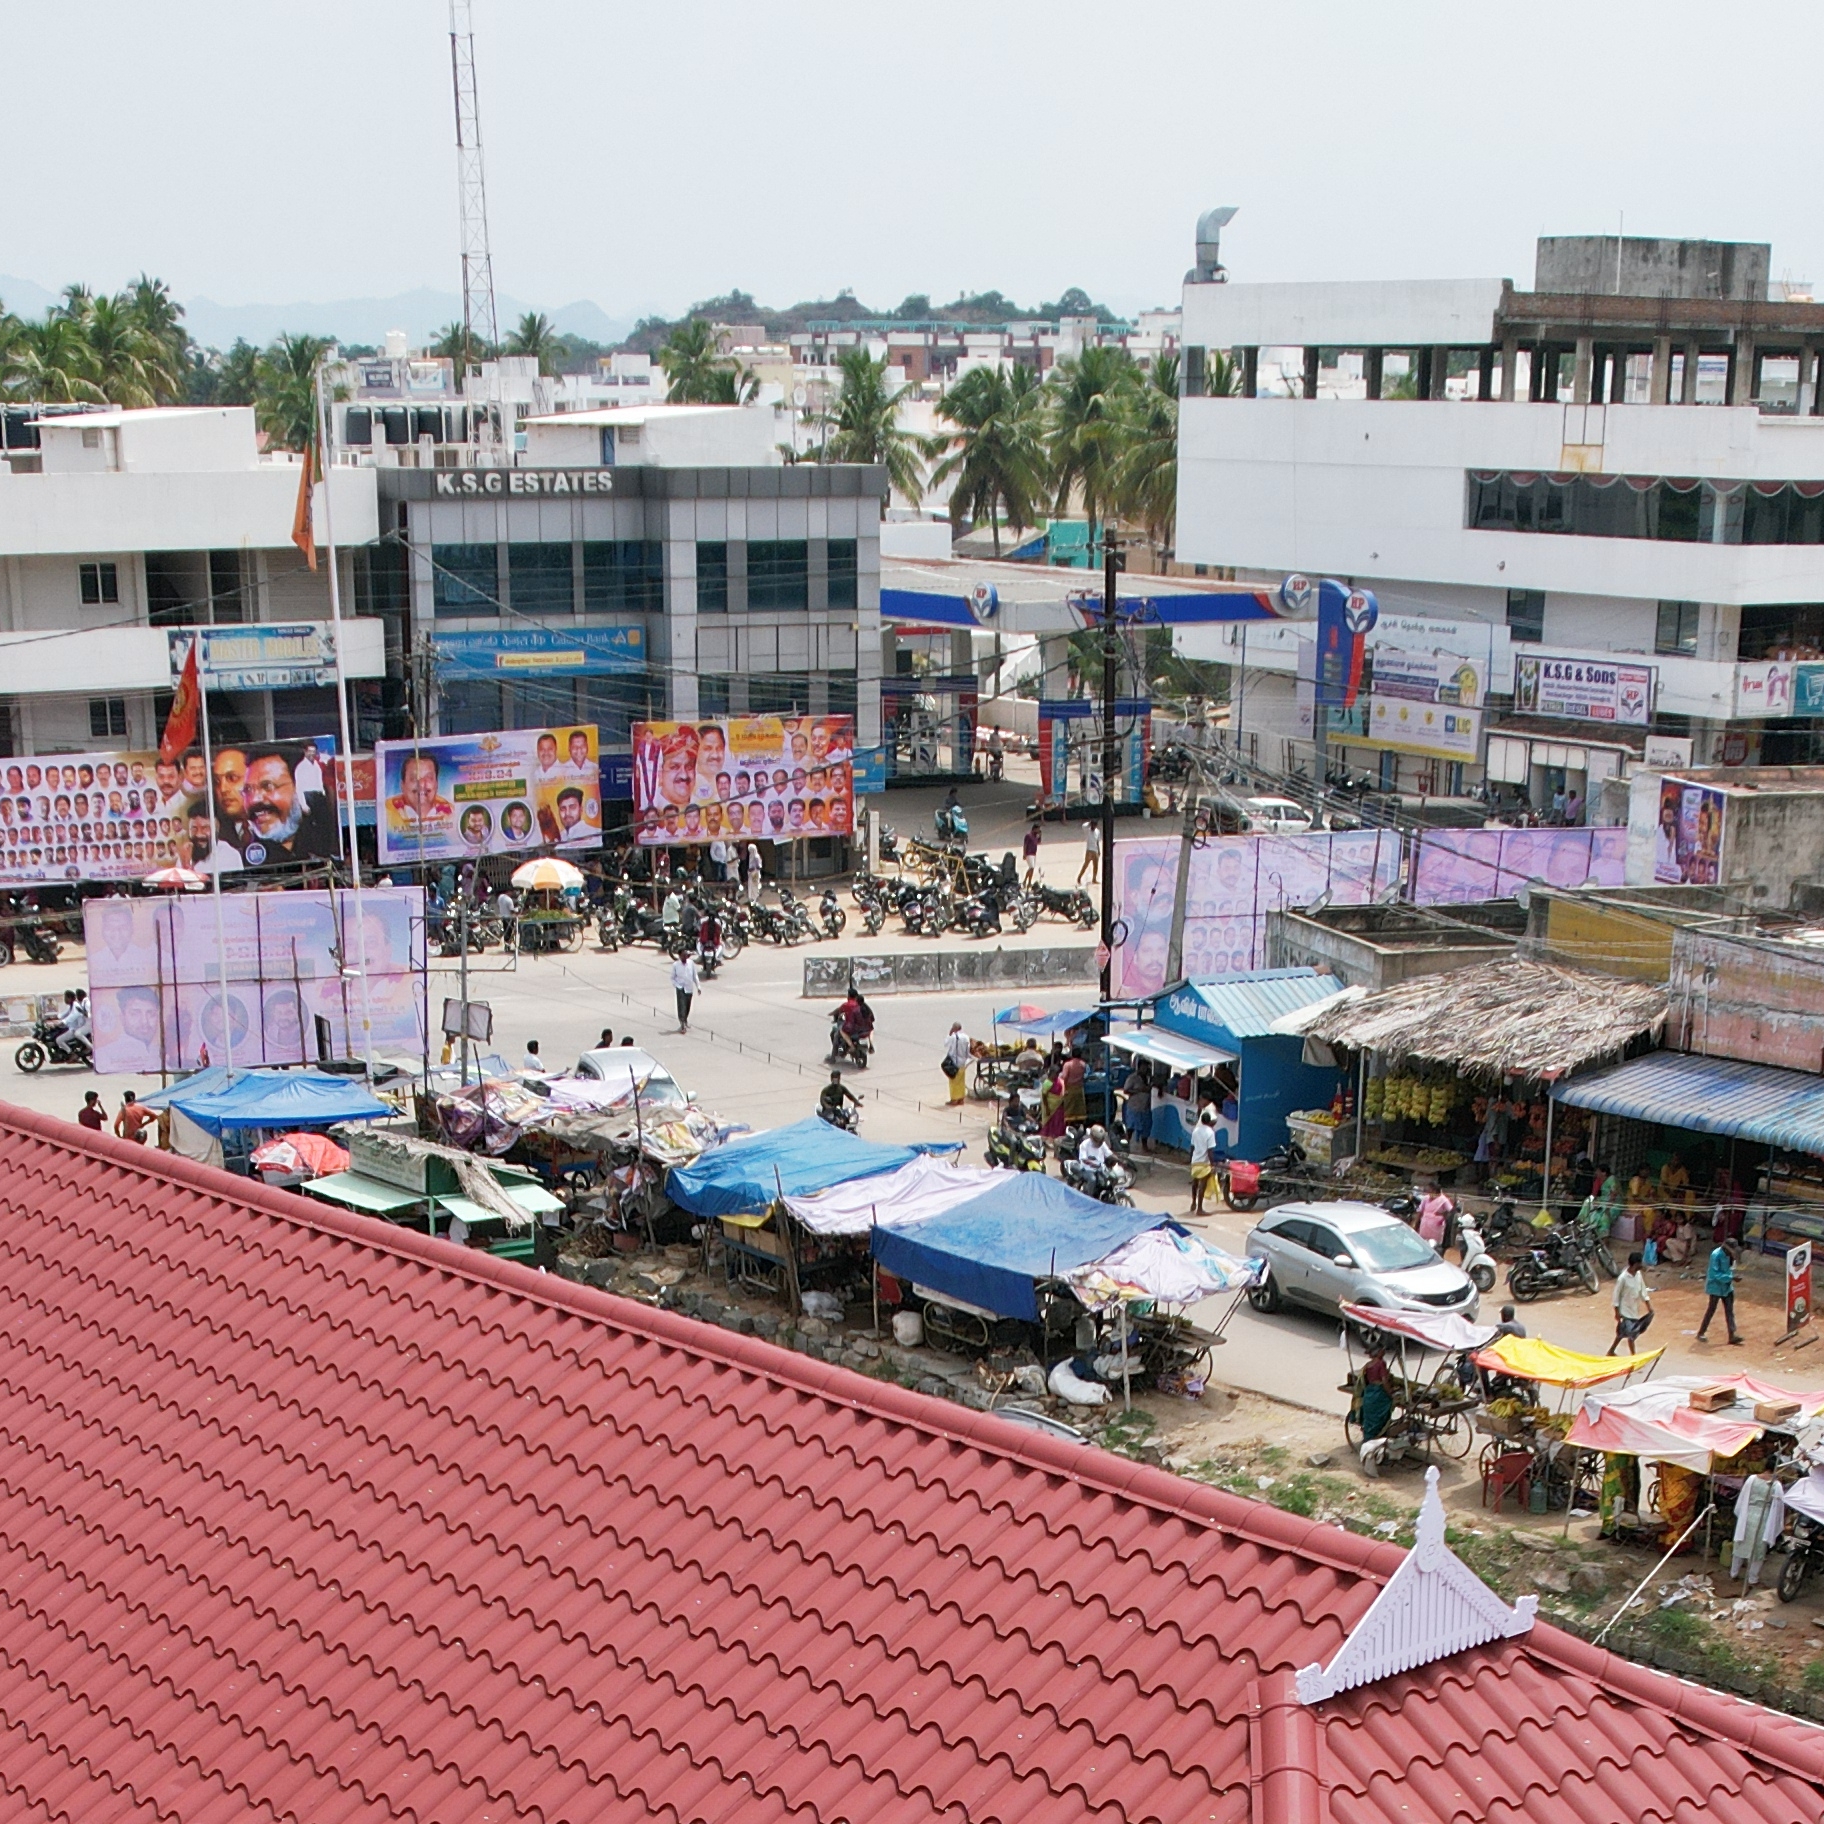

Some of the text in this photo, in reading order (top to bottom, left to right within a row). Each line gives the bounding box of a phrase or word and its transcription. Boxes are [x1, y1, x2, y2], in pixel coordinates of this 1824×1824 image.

[436, 469, 613, 497] K.S.G ESTATES
[1293, 580, 1307, 591] HP
[976, 588, 987, 598] HP
[1351, 596, 1364, 609] HP
[1544, 662, 1573, 681] K.S.G
[1575, 667, 1583, 682] &
[1587, 666, 1616, 685] Sons
[1626, 690, 1640, 700] HP
